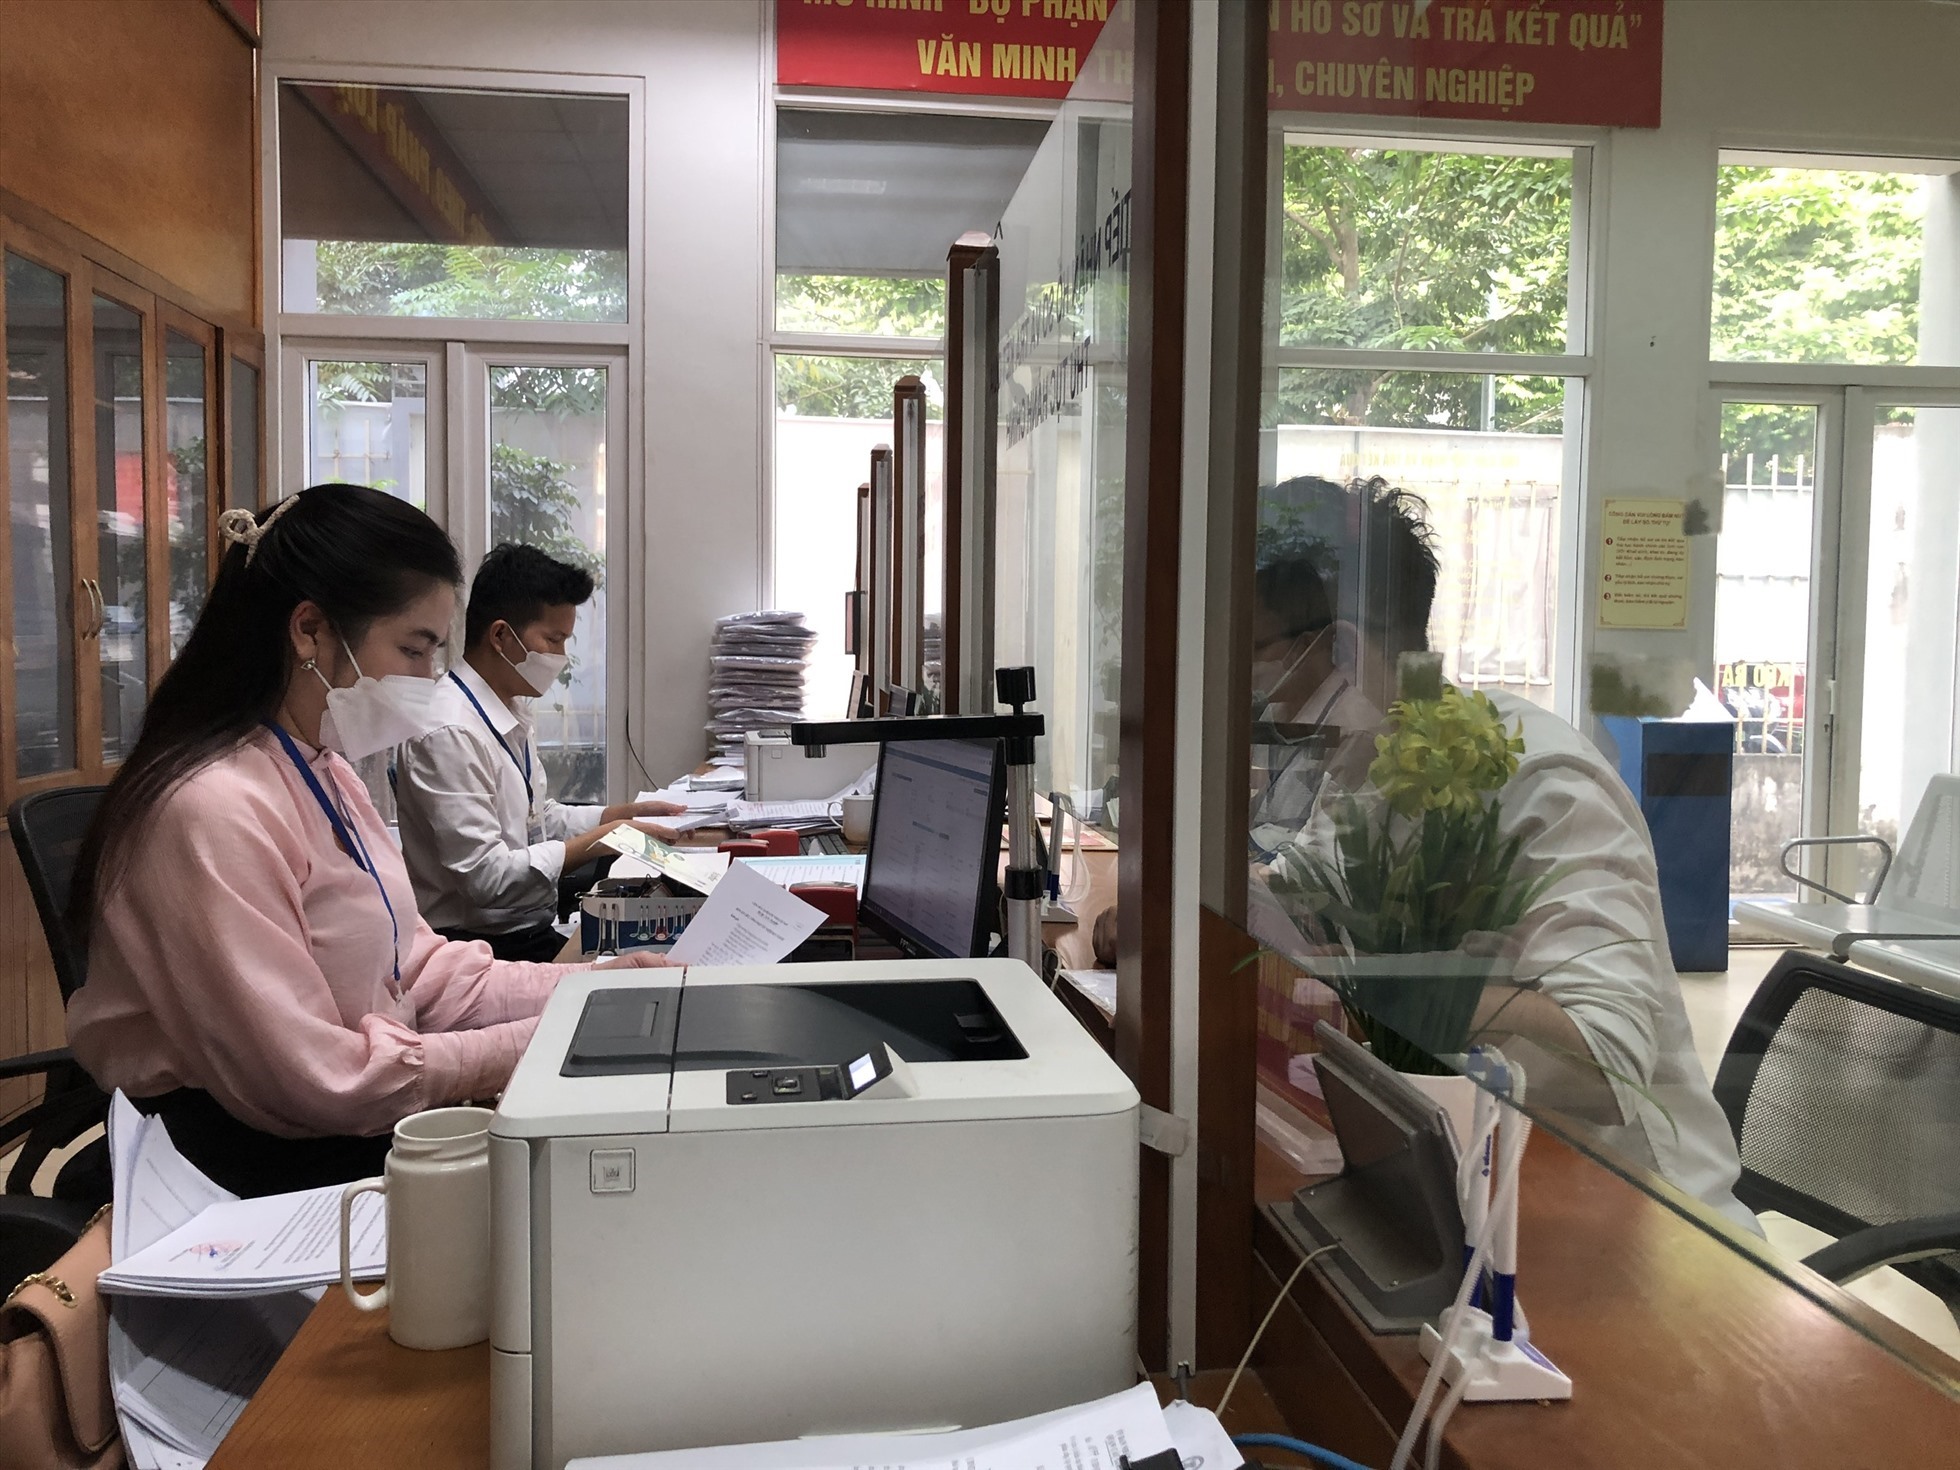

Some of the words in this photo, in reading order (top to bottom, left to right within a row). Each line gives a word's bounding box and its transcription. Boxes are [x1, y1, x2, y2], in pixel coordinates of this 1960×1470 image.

[1505, 0, 1560, 46] KẾT
[916, 33, 982, 78] VĂN
[992, 43, 1076, 82] MINH
[1295, 57, 1415, 101] CHUYÊN
[1426, 64, 1536, 113] NGHIỆP
